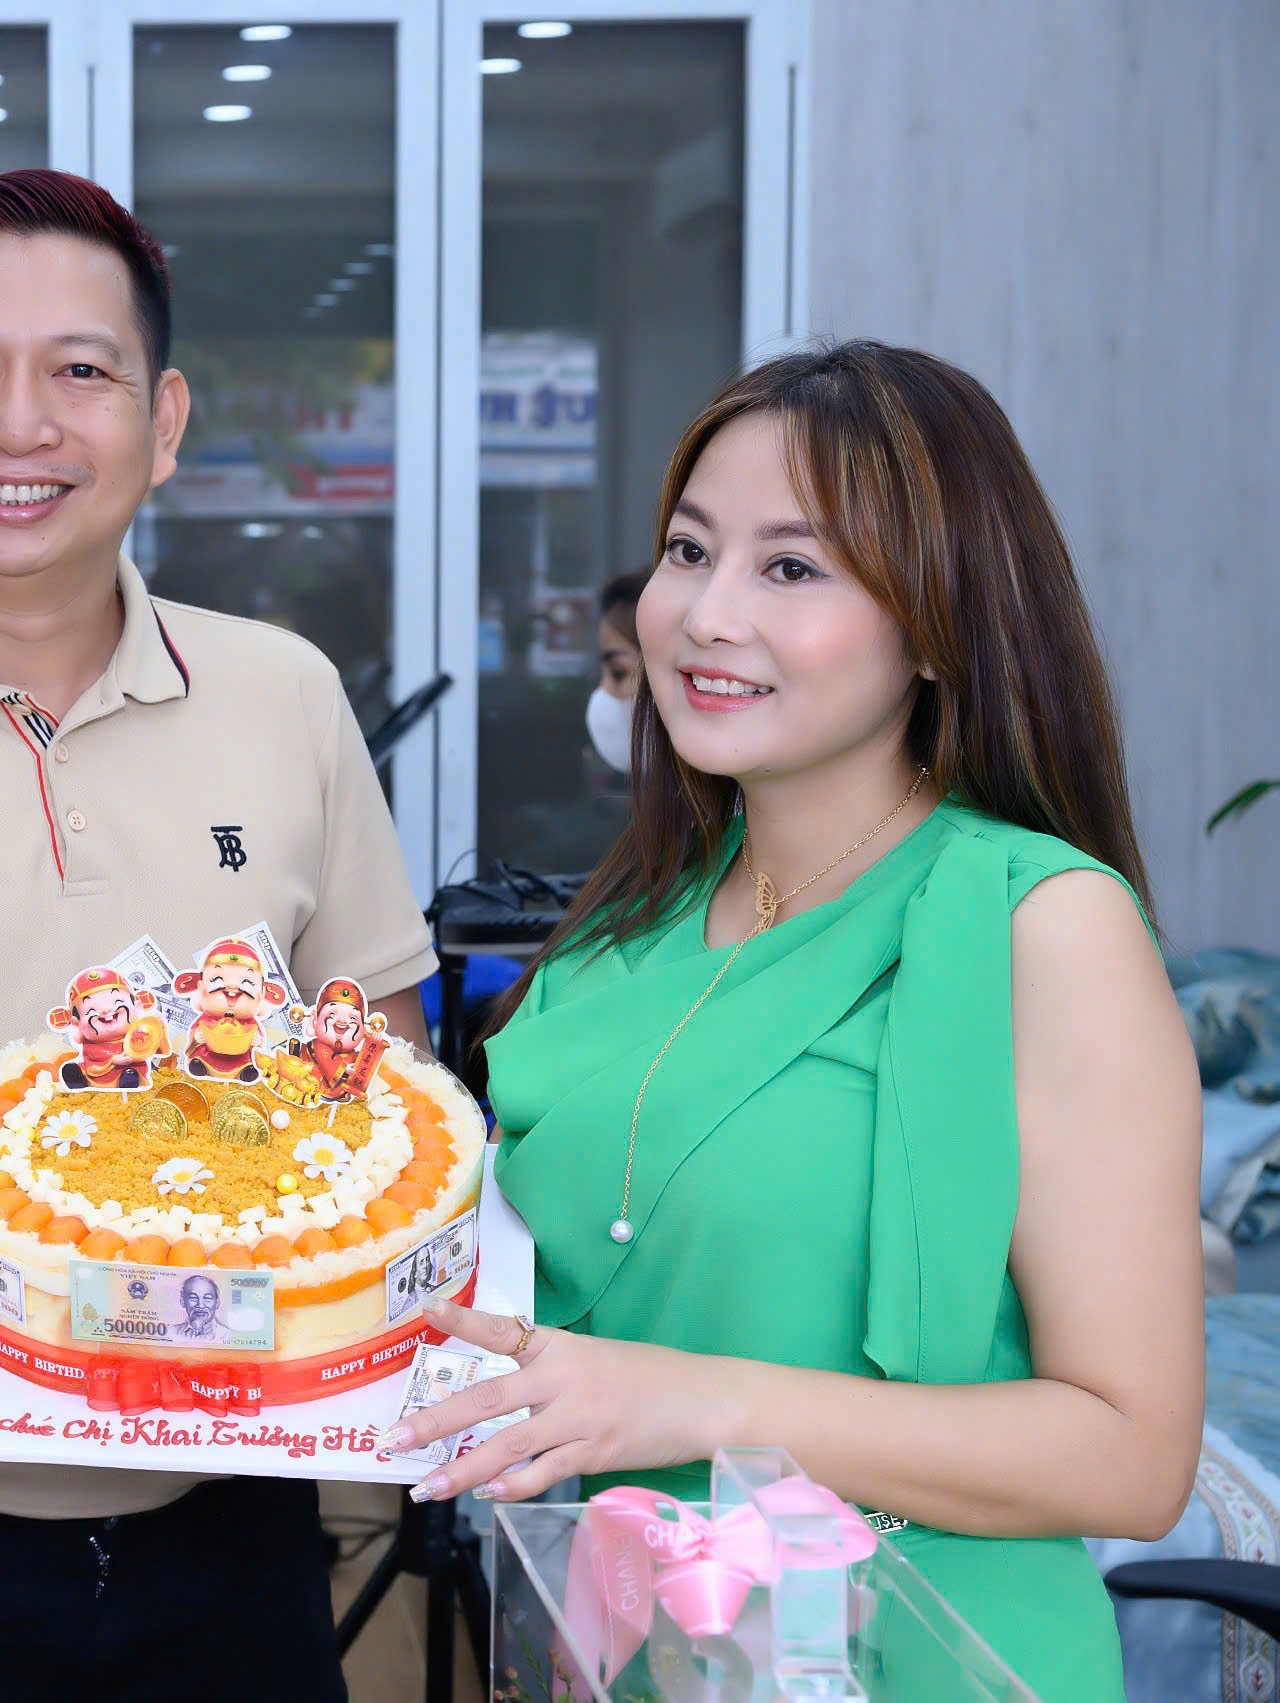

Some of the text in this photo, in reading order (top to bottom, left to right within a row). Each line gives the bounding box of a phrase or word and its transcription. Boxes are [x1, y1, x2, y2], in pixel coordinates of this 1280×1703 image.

[103, 1318, 168, 1337] 500000
[33, 1356, 87, 1379] BIRTHD
[321, 1358, 366, 1381] HAPPY
[371, 1330, 428, 1366] BIRTHDAY
[62, 1418, 115, 1447] Chị
[120, 1416, 203, 1447] Khai
[321, 1423, 392, 1463] Hồ
